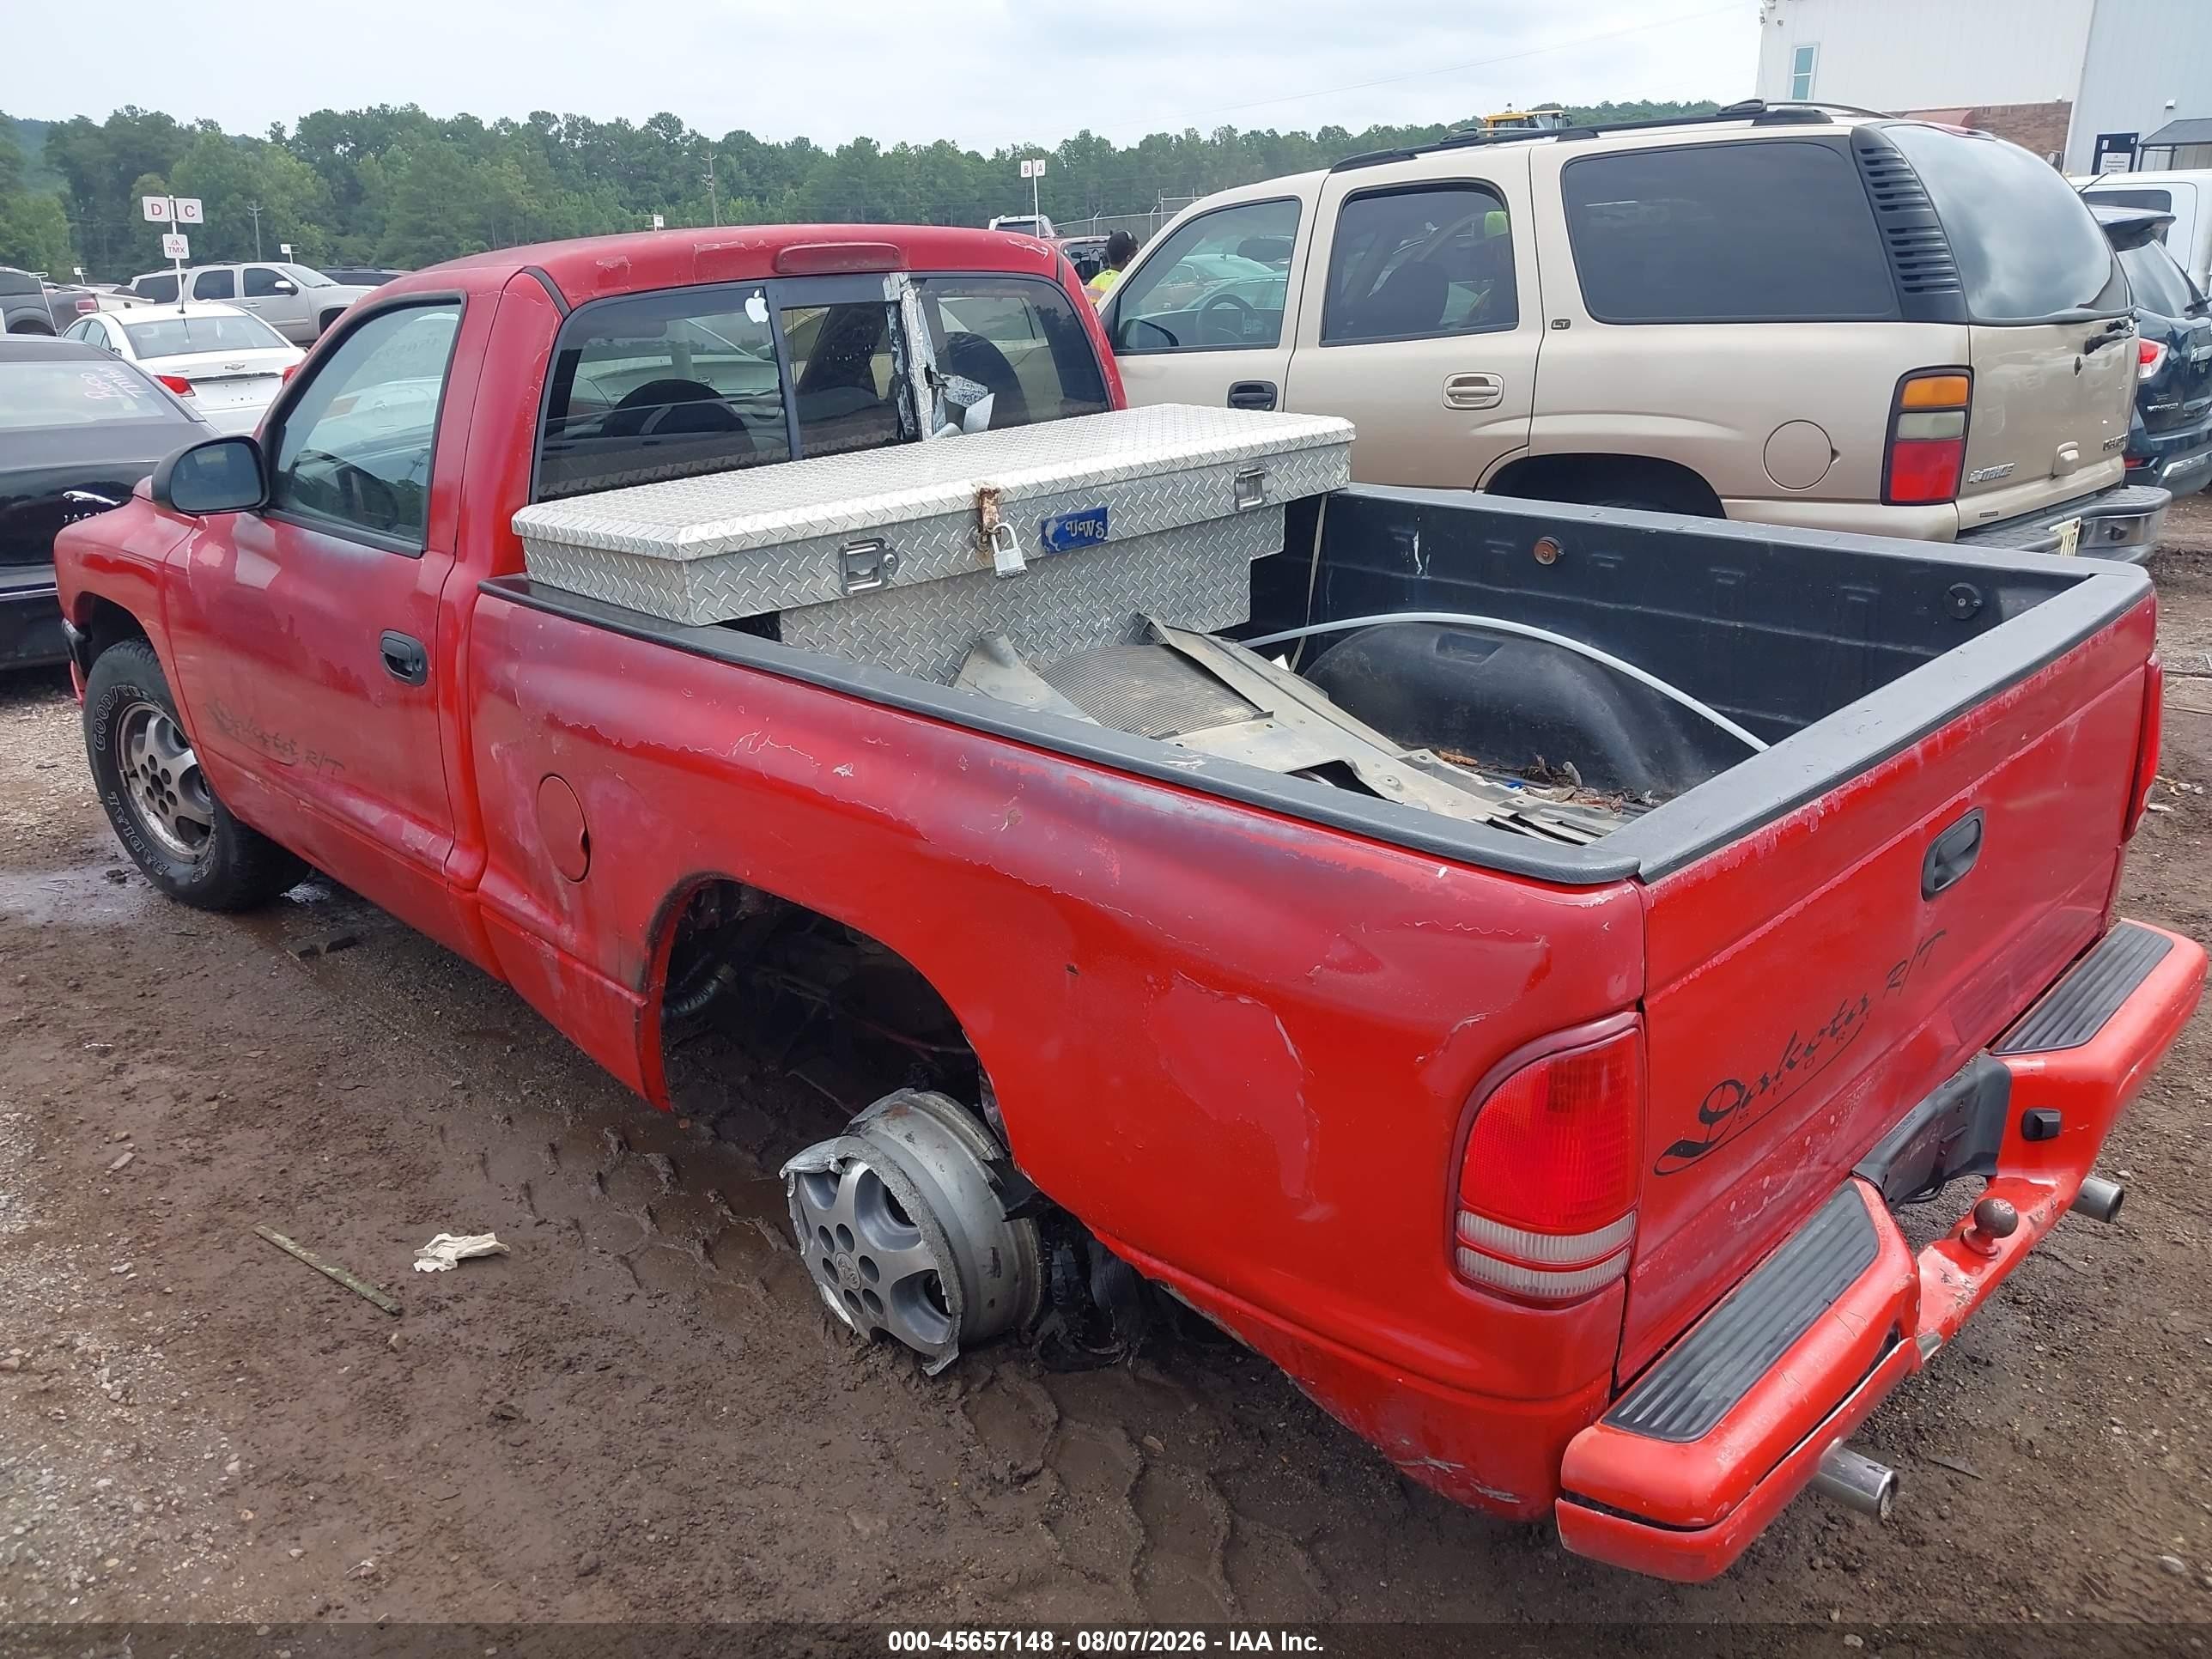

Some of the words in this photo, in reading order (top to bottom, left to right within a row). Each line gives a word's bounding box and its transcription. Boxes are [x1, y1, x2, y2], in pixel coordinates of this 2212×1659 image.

[1037, 164, 1043, 173] A
[150, 203, 162, 216] D
[184, 204, 196, 218] C
[1551, 319, 1571, 330] LT
[1065, 519, 1105, 539] UWS
[304, 748, 345, 775] R/T
[108, 791, 169, 876] RADIAL
[1653, 993, 1869, 1176] Dakota
[1883, 928, 1947, 999] R/T
